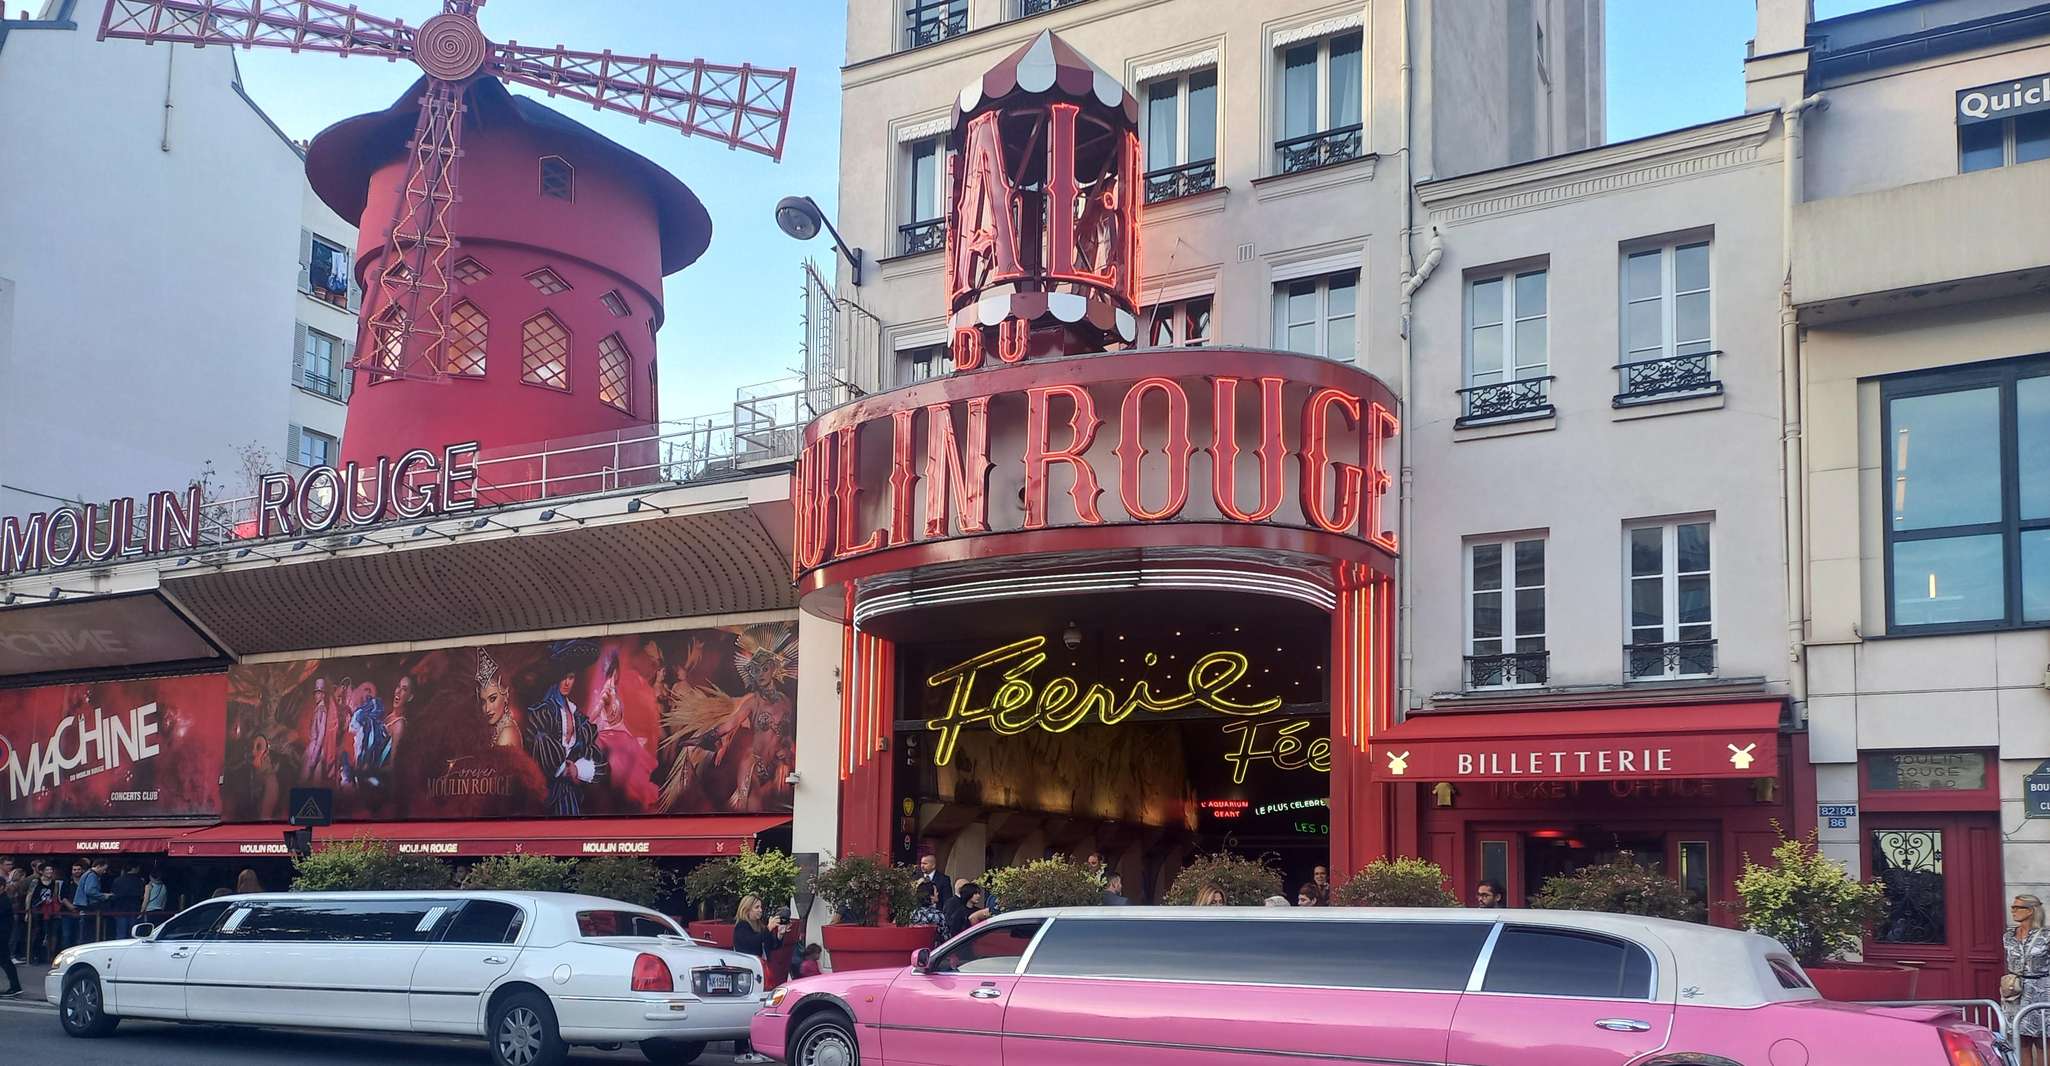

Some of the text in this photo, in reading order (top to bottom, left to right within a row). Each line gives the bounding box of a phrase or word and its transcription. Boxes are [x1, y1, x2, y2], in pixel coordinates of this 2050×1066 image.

[955, 319, 1028, 370] DU
[1022, 376, 1400, 554] ROUGE
[0, 441, 479, 575] MOULIN ROUGE
[926, 635, 1281, 766] Féerie
[9, 701, 159, 800] MACHINE
[1457, 748, 1672, 775] BILLETTERIE
[111, 791, 158, 801] CONCERTS CLUB
[1255, 807, 1265, 815] LE
[1267, 803, 1288, 813] PLUS
[1821, 807, 1854, 815] 82 84
[1294, 822, 1316, 833] LES
[1830, 818, 1845, 827] 86
[76, 841, 120, 850] MOULIN ROUGE
[240, 844, 288, 854] MOULIN ROUG
[430, 844, 458, 853] ROUGE
[582, 842, 650, 853] MOULIN ROUGE
